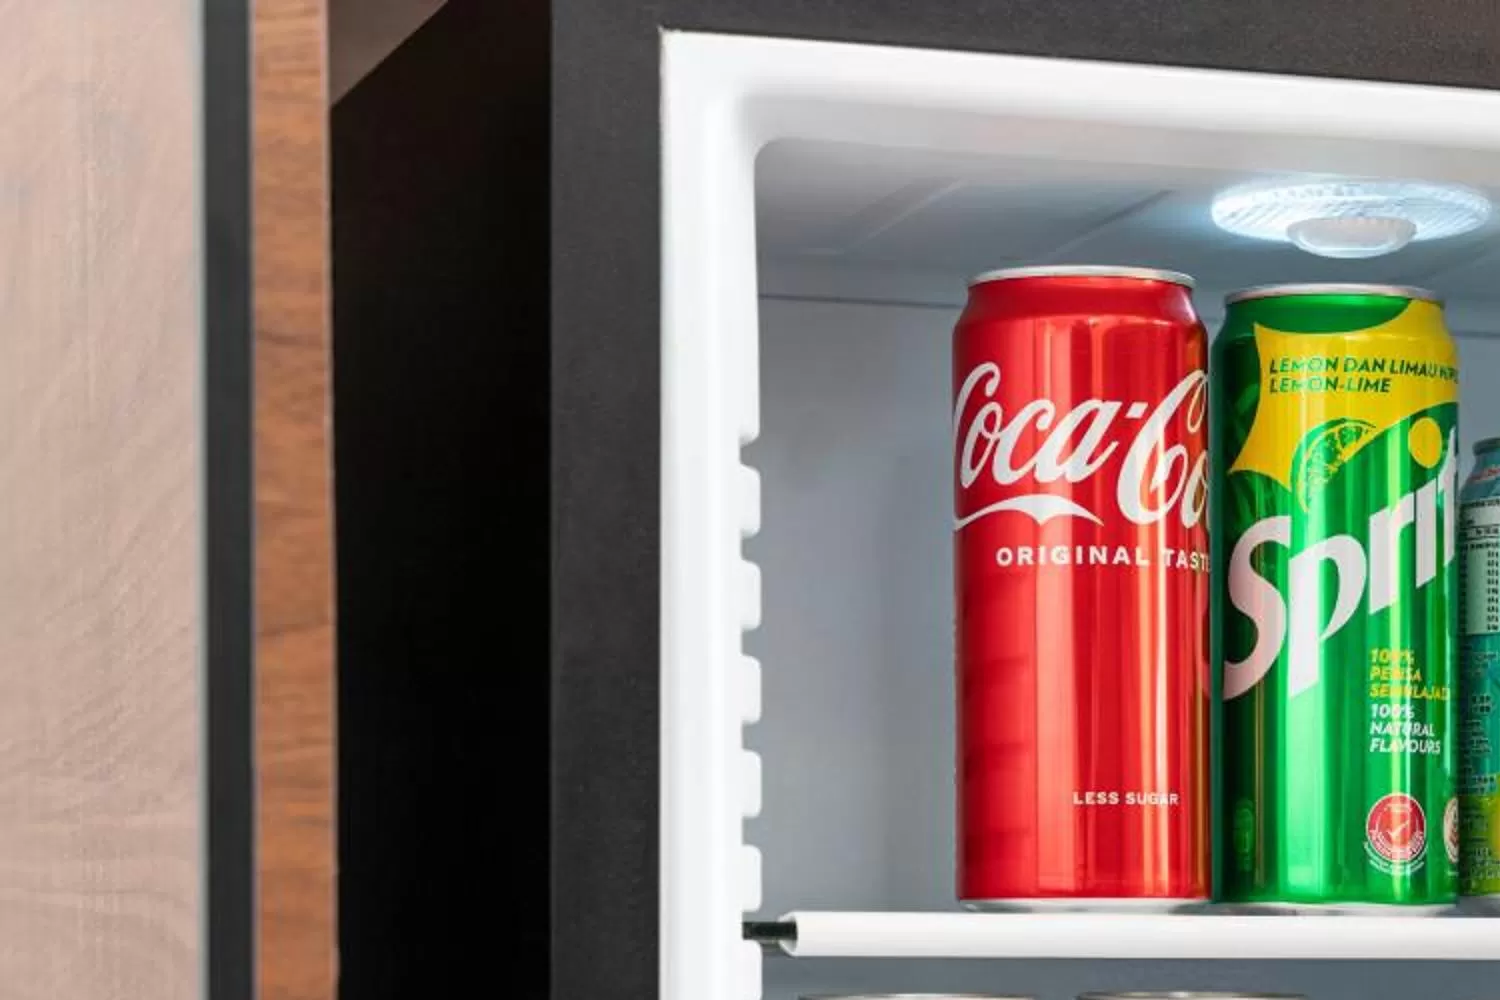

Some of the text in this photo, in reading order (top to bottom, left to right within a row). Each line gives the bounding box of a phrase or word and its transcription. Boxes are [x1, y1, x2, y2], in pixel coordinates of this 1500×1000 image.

[1269, 356, 1339, 374] LEMON
[1343, 357, 1385, 374] DAN
[1389, 359, 1438, 378] LIMAU
[1269, 376, 1392, 394] LEMON-LIME
[995, 545, 1150, 567] ORIGINAL
[1370, 648, 1415, 665] 100%
[1370, 703, 1416, 719] 100%
[1369, 721, 1435, 737] NATURAL
[1369, 737, 1441, 755] FLAVOURS
[1072, 791, 1179, 806] LESS SUGAR
